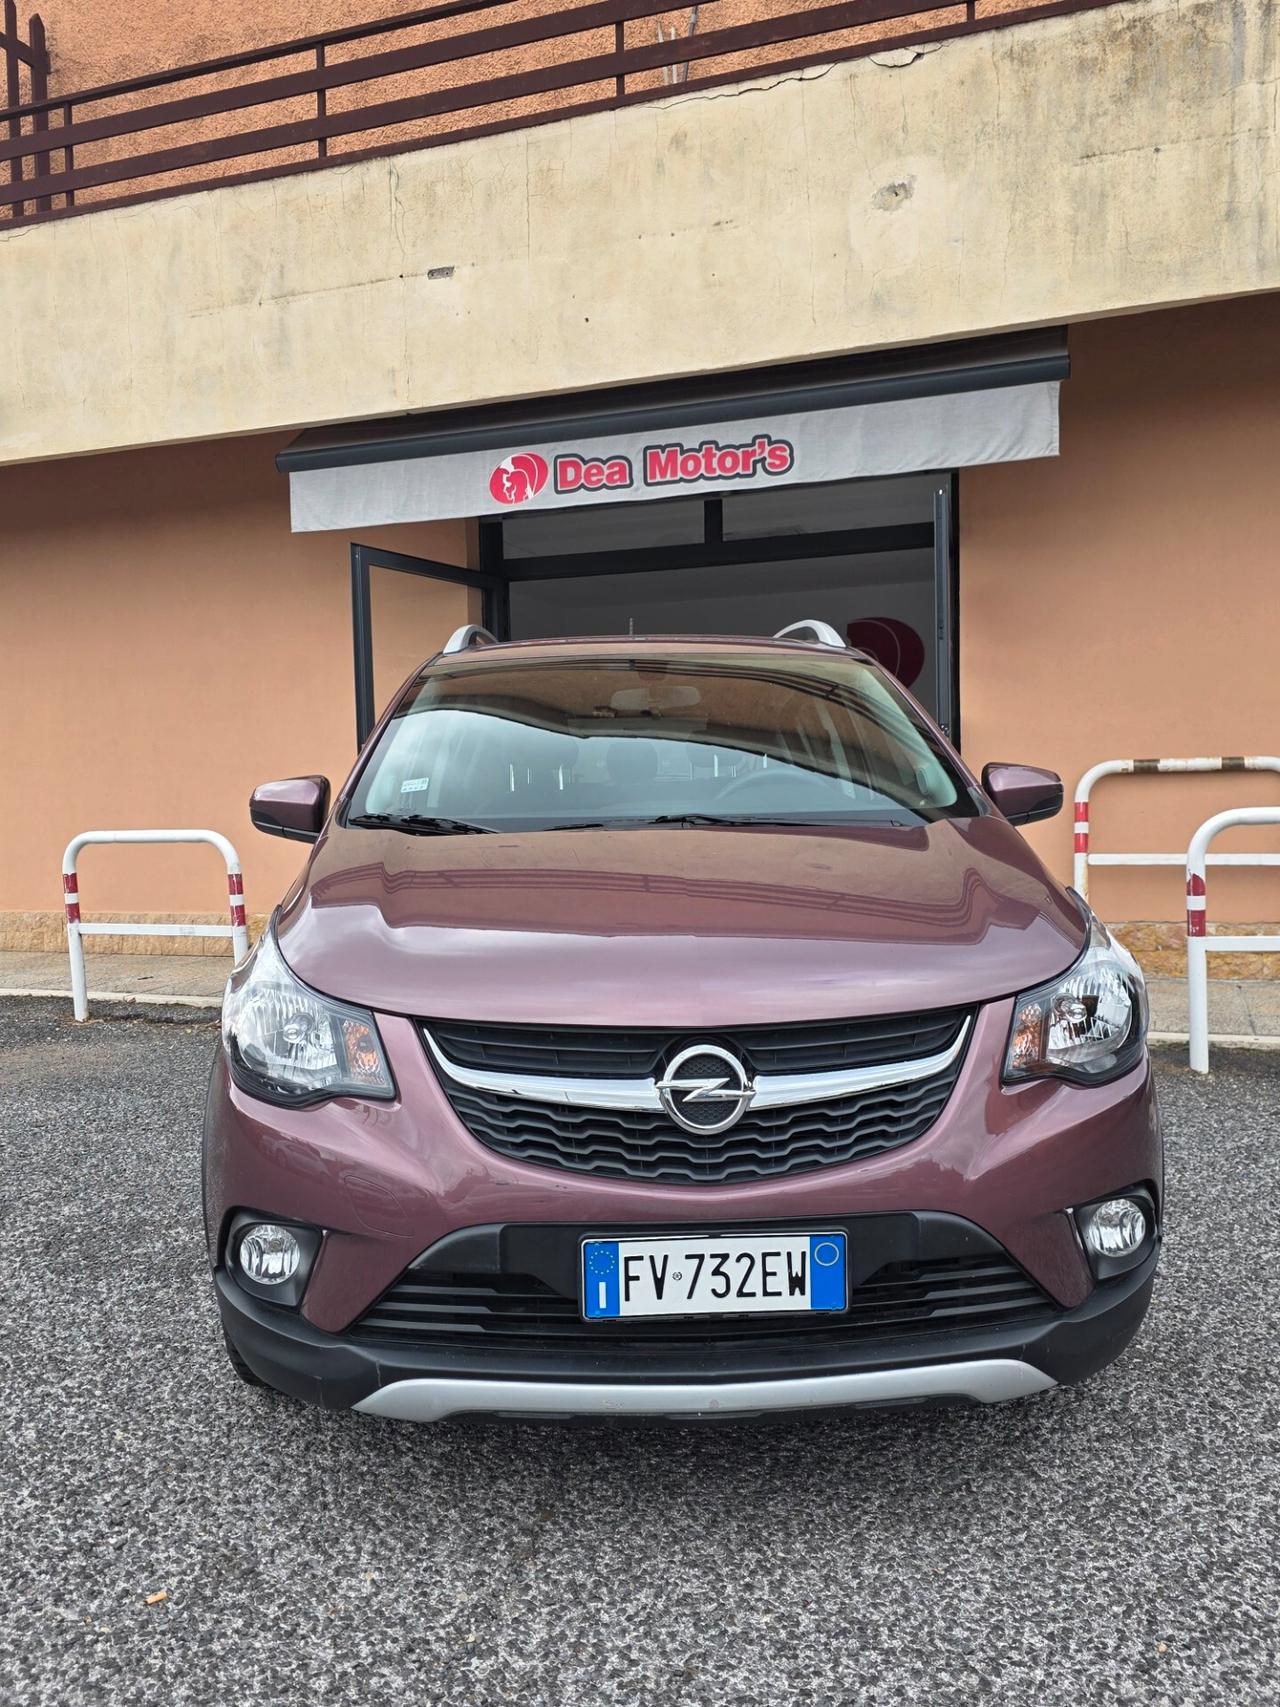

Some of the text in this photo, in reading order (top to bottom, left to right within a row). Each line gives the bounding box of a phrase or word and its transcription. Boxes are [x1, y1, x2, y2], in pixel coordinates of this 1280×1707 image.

[557, 438, 791, 492] Dea Motor's
[599, 1282, 606, 1308] I
